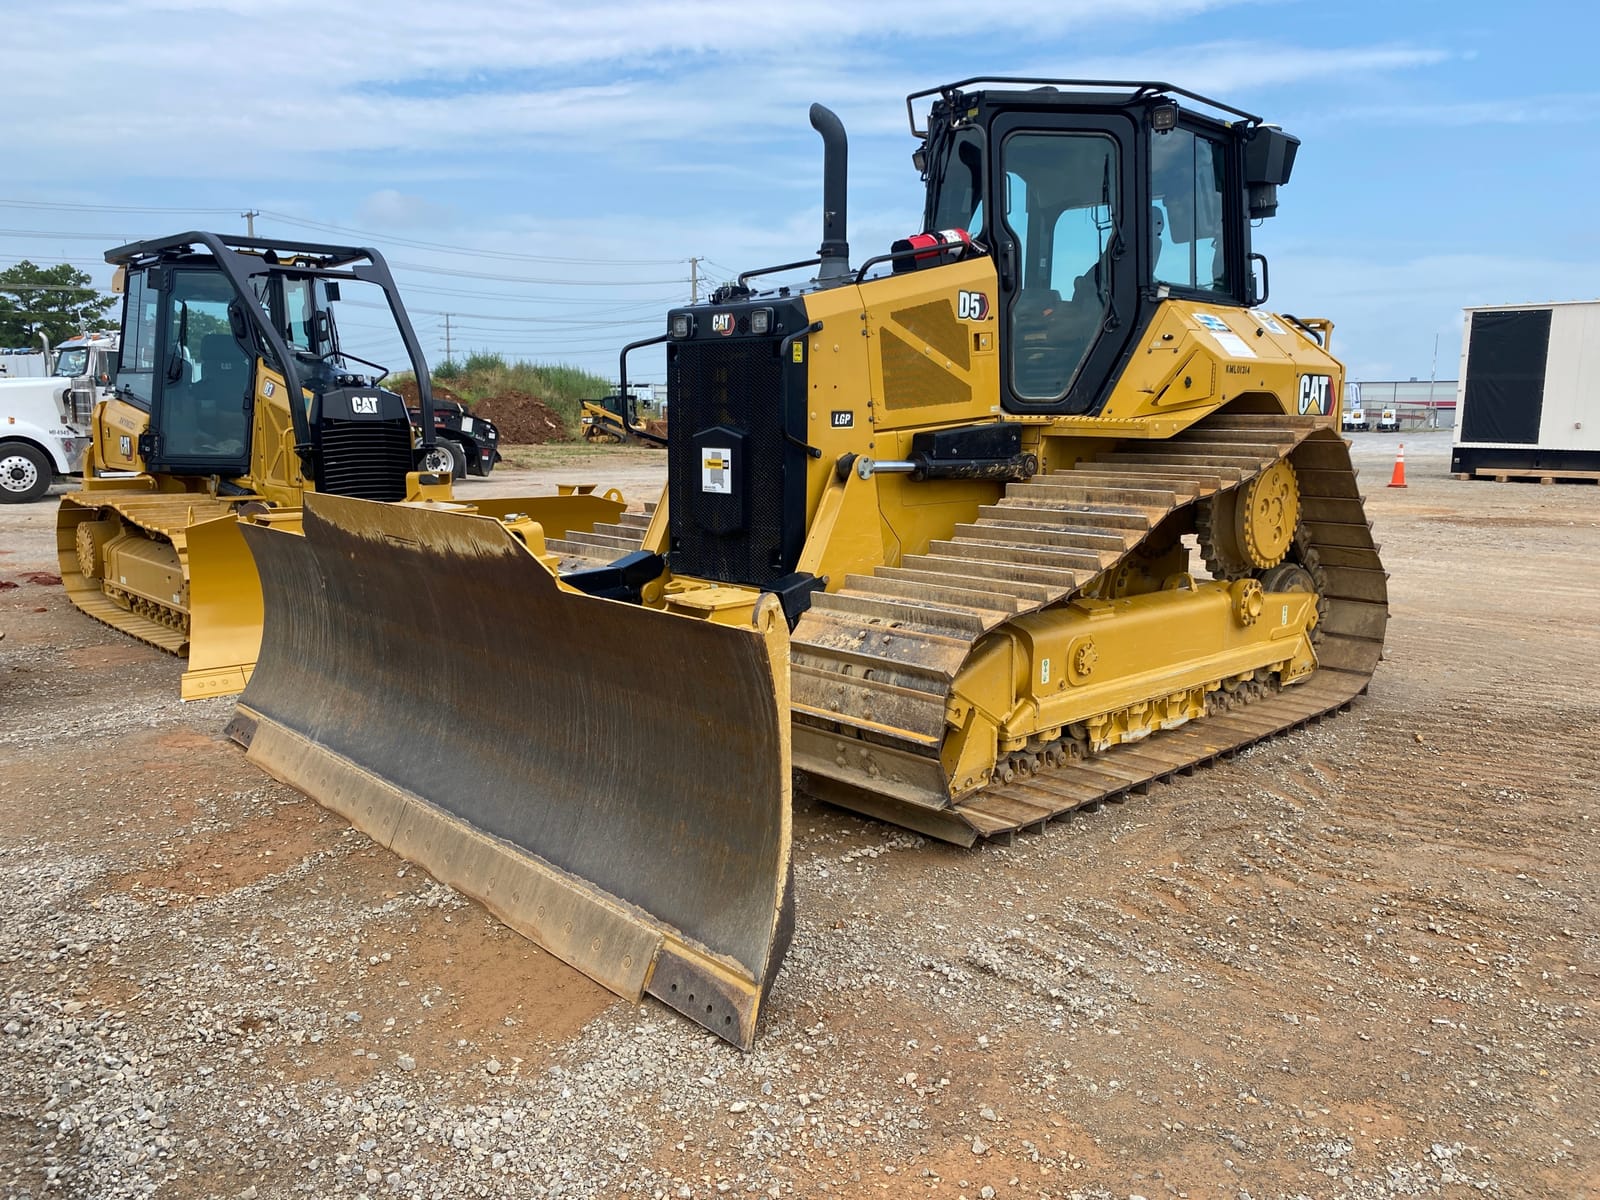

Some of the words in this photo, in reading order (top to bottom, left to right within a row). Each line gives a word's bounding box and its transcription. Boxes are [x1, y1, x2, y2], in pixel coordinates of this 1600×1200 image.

[958, 291, 980, 319] D5
[712, 314, 730, 331] CAT
[1298, 374, 1329, 415] CAT
[351, 396, 378, 414] CAT
[834, 413, 851, 425] LGP
